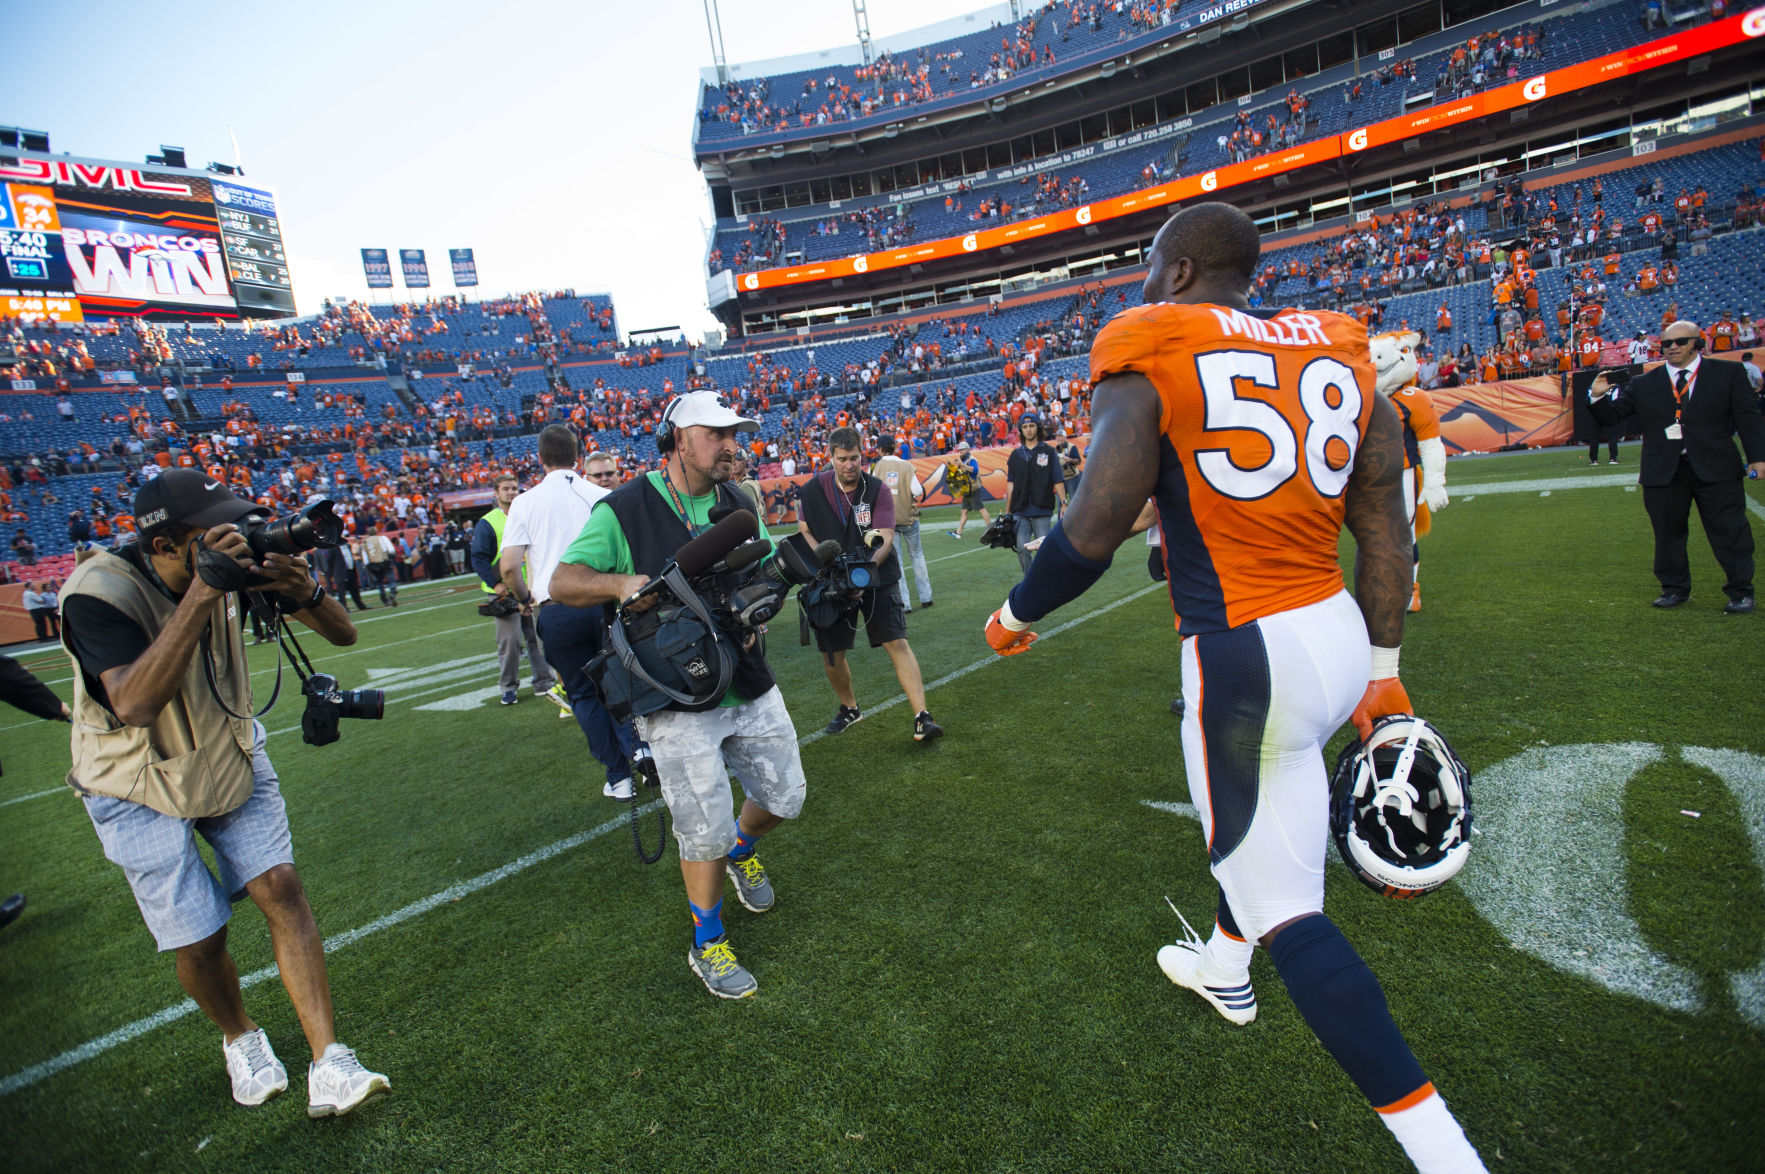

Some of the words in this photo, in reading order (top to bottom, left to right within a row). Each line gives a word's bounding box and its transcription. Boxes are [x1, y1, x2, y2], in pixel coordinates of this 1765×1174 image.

[1199, 7, 1222, 23] DAN
[1225, 0, 1261, 13] REEV
[1523, 76, 1546, 100] G
[1128, 133, 1142, 144] call
[1349, 129, 1367, 150] G
[997, 170, 1012, 179] with
[1014, 166, 1027, 176] info
[1034, 157, 1062, 169] location
[1201, 172, 1217, 191] G
[889, 194, 902, 202] Fan
[926, 185, 940, 194] text
[231, 195, 275, 212] SCORES
[22, 206, 52, 225] 34
[229, 211, 249, 223] NYJ
[1076, 206, 1091, 224] G
[232, 220, 252, 231] BUF
[61, 227, 220, 253] BRONCOS
[962, 235, 977, 251] G
[1, 244, 53, 258] FINAL
[237, 246, 258, 256] CAR
[63, 244, 230, 295] WIN
[853, 257, 868, 273] G
[242, 271, 262, 280] CLE
[745, 273, 759, 289] G
[1209, 309, 1332, 345] MILLER
[1583, 342, 1599, 353] 84
[1192, 349, 1363, 501] 58
[666, 481, 685, 514] BRONCOS
[856, 511, 871, 523] NFL
[1377, 873, 1439, 888] BRONCOS
